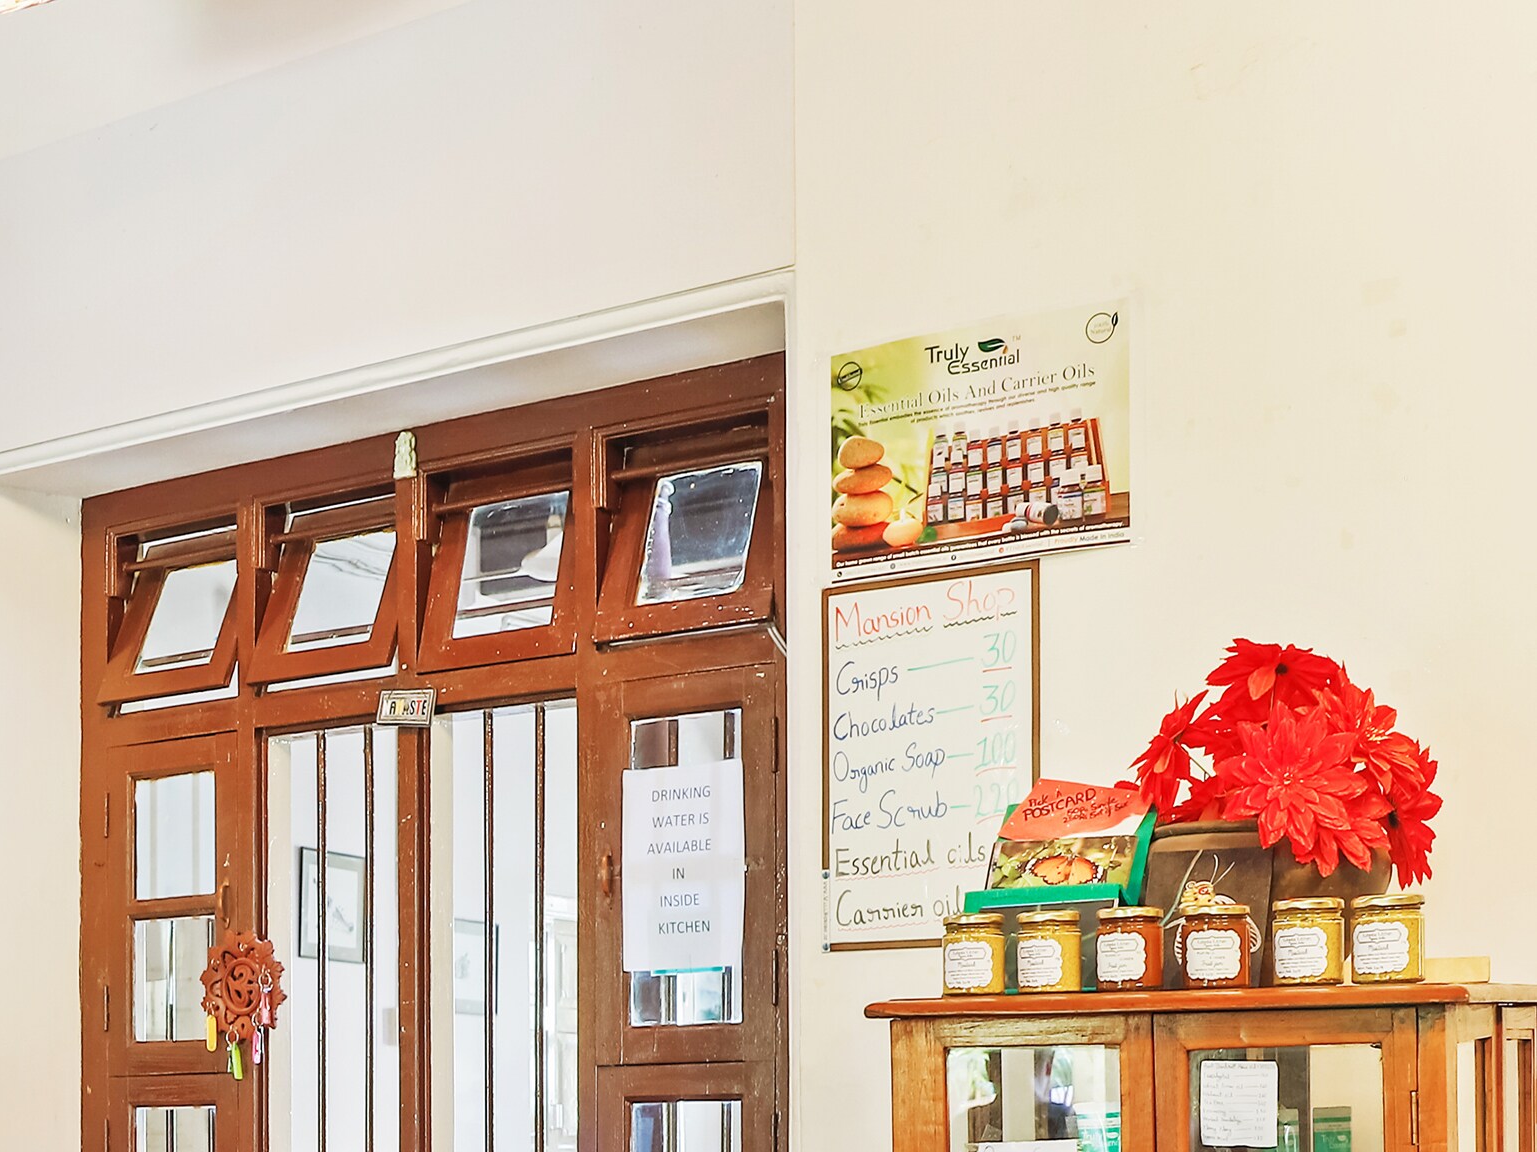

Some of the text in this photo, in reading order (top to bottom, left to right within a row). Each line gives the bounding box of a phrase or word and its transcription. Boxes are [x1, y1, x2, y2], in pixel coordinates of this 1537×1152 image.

[925, 342, 969, 365] Truly
[947, 349, 1020, 376] Essential
[858, 363, 1096, 419] Essential Oils And Carrier Oils
[835, 580, 1016, 642] Mansion Shop
[836, 630, 1016, 701] Crisps 30
[833, 680, 1016, 741] Chocolates 30
[833, 730, 1017, 793] Organic Soap 100
[652, 785, 711, 803] DRINKING
[1022, 788, 1097, 821] POSTCARD
[652, 812, 709, 828] WATER IS
[832, 800, 871, 835] Face
[876, 789, 948, 829] Scrub
[647, 838, 712, 855] AVAILABLE
[835, 838, 935, 877] Essential
[672, 867, 685, 880] IN
[660, 893, 700, 907] INSIDE
[836, 890, 924, 927] Carrier
[658, 920, 711, 935] KITCHEN
